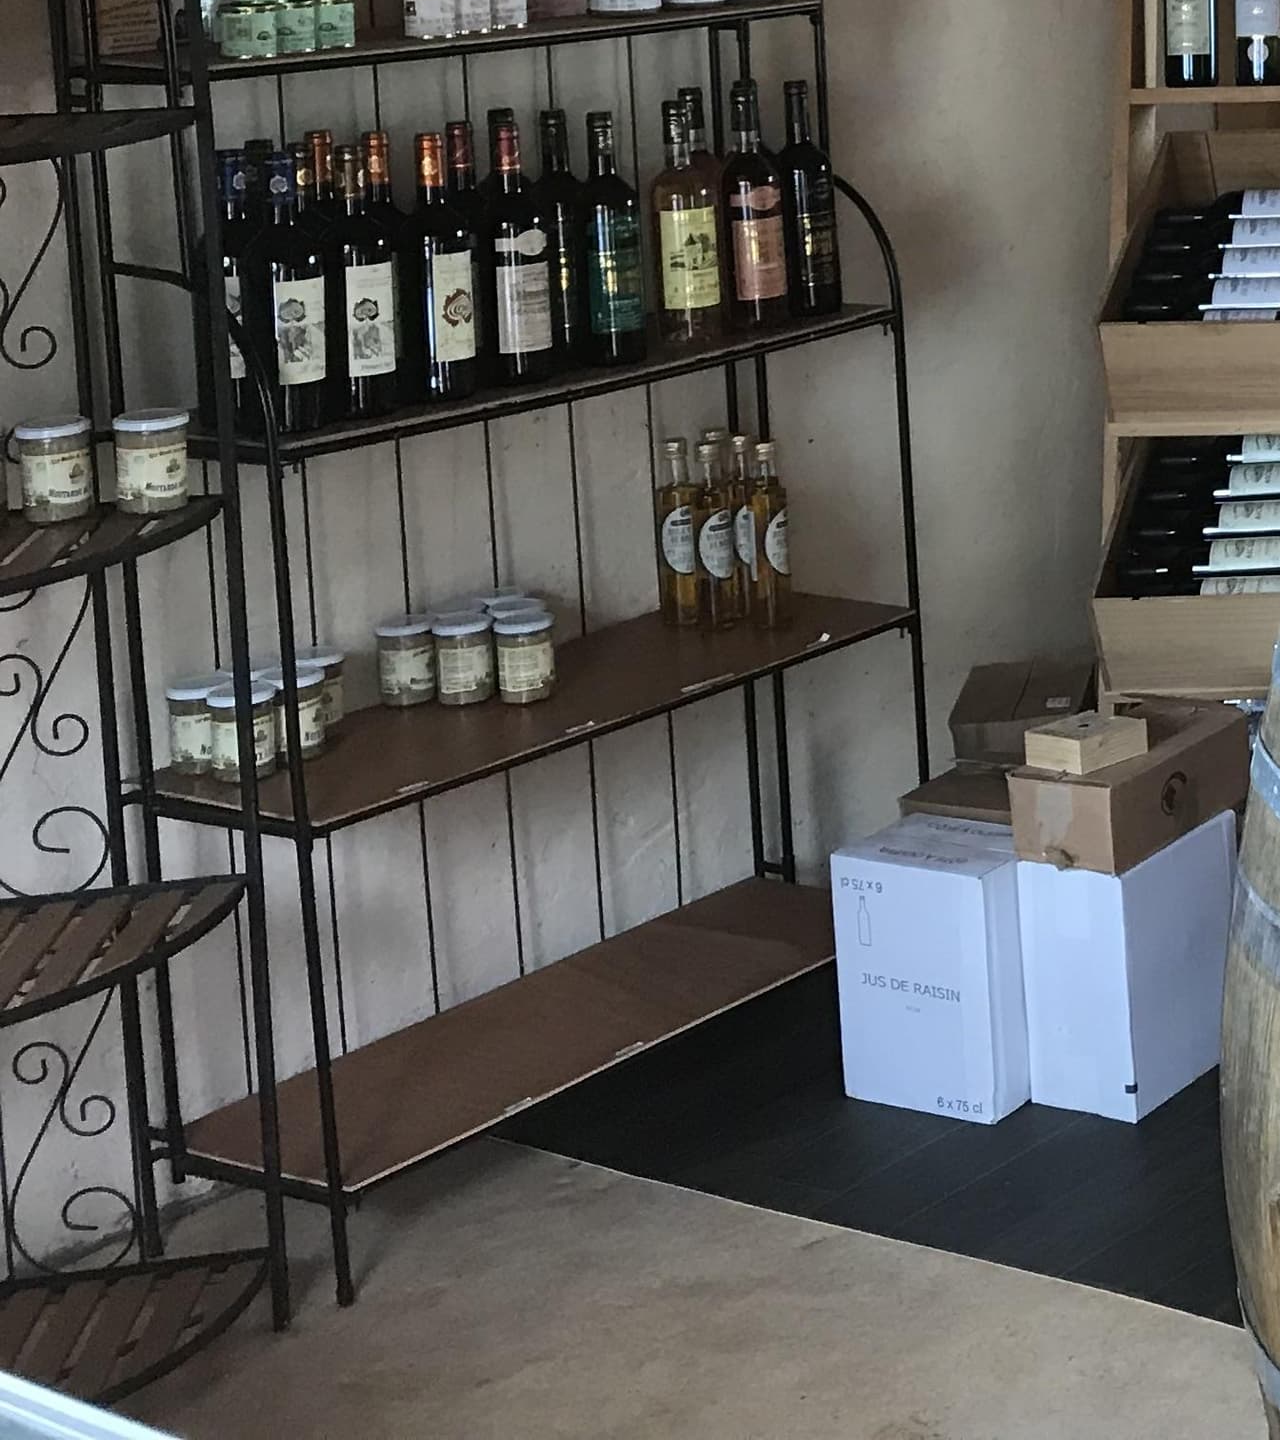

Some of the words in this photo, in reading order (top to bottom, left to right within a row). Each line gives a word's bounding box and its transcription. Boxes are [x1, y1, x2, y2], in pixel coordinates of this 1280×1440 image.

[861, 972, 887, 988] JUS
[890, 978, 909, 992] DE
[913, 983, 961, 1003] RAISIN
[937, 1096, 945, 1108] 6
[957, 1099, 969, 1113] 75
